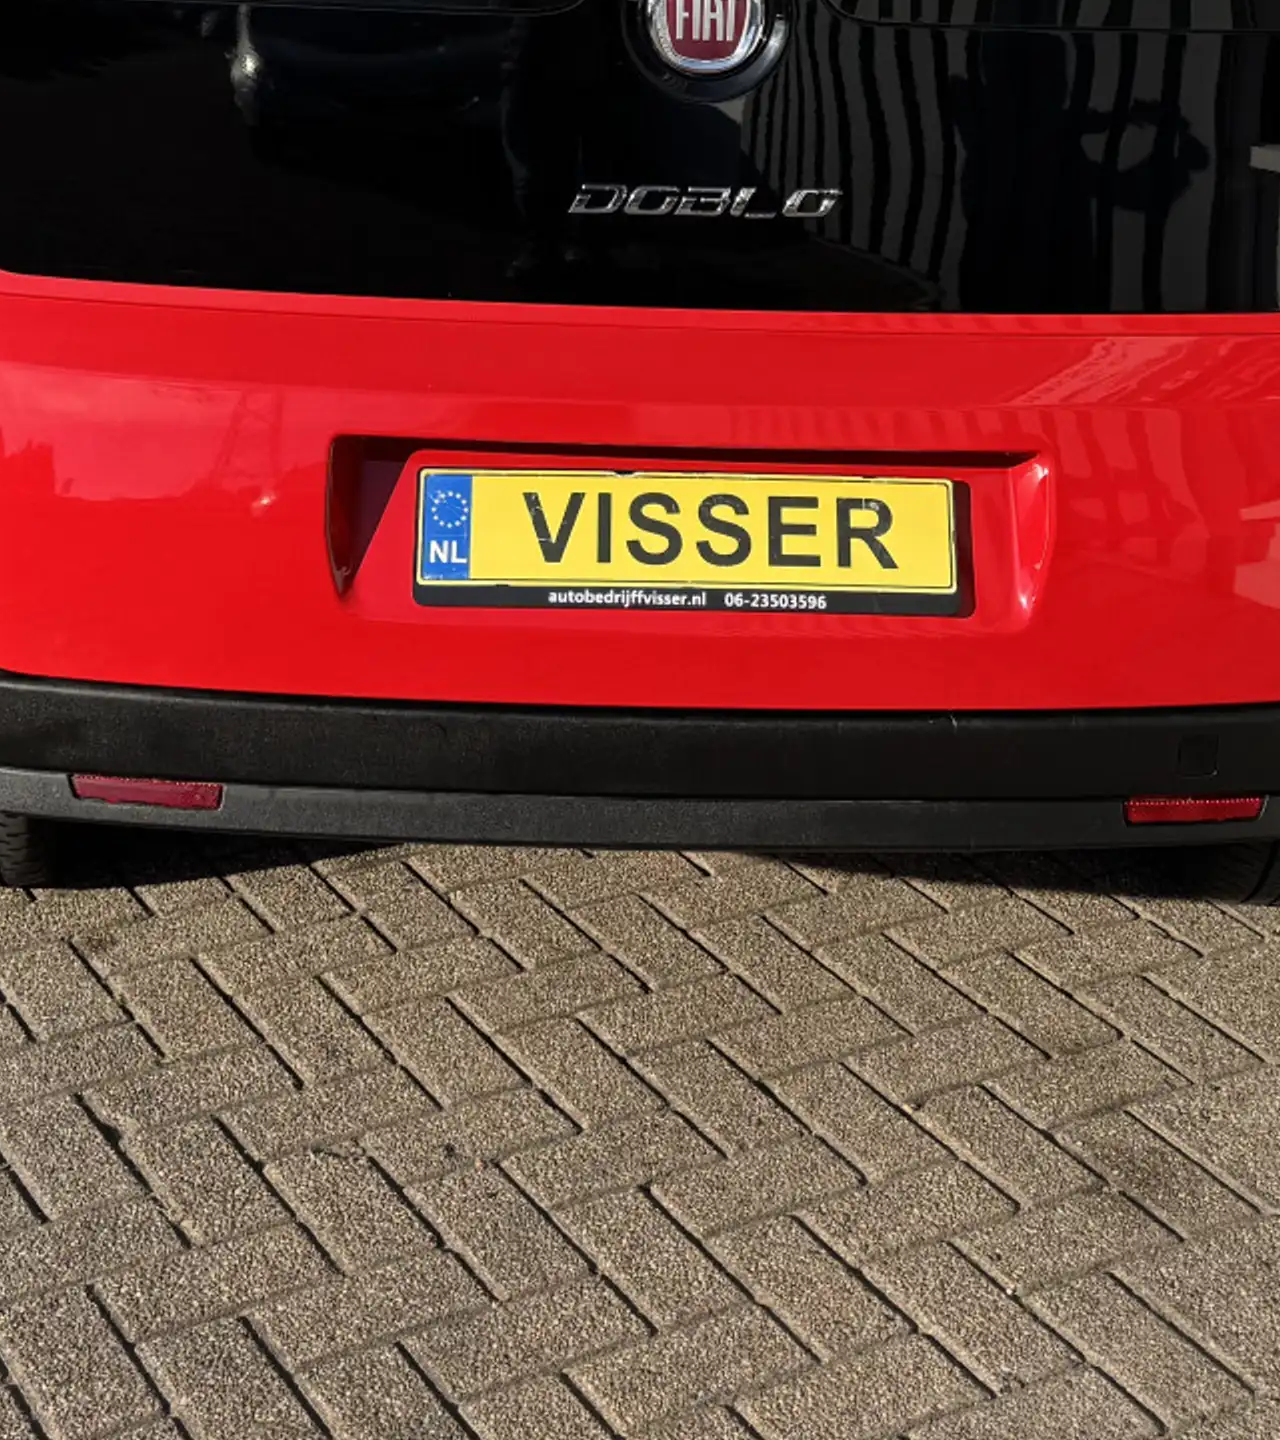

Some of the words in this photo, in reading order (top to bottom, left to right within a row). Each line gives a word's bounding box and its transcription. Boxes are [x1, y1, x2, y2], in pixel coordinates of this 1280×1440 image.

[429, 539, 468, 564] NL
[522, 491, 899, 569] VISSER
[548, 589, 707, 608] autobedrijffvisser.nl
[724, 592, 827, 610] 06-23503596
